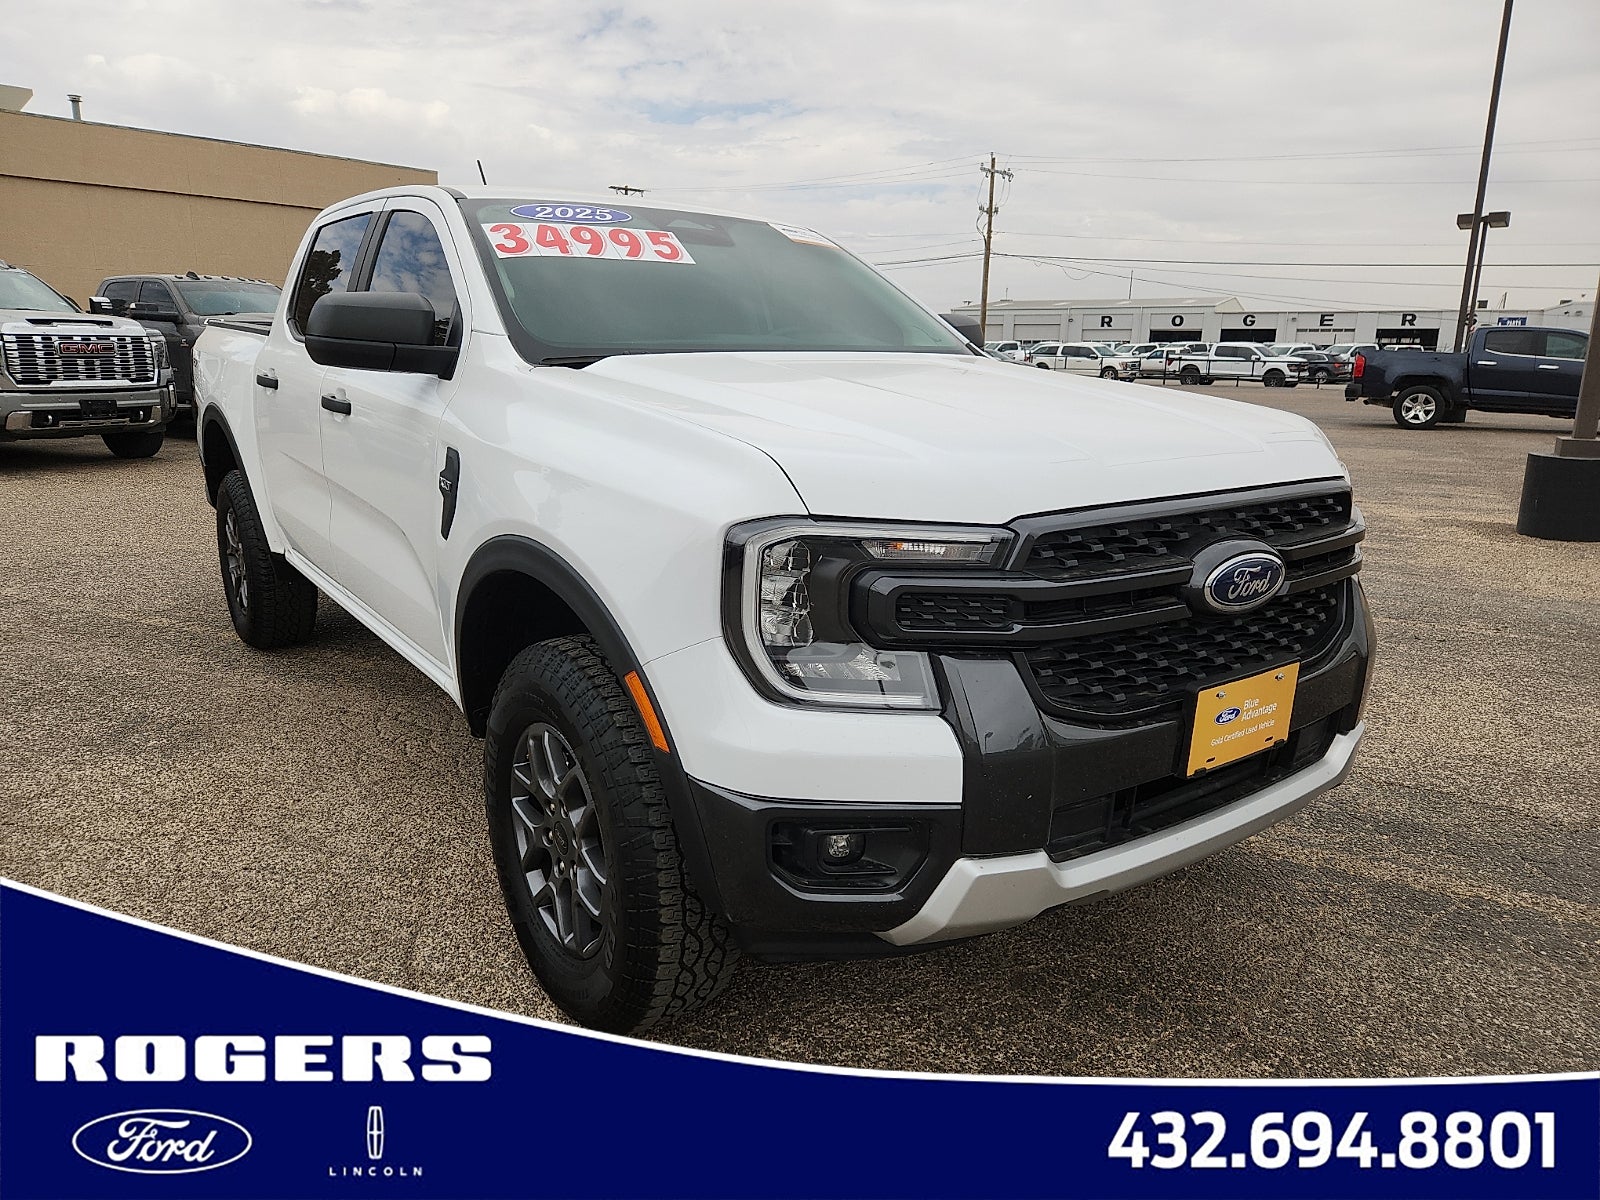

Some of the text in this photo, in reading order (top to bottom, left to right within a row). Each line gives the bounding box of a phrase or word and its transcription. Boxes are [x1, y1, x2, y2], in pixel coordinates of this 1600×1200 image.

[534, 205, 613, 221] 2025
[488, 223, 684, 261] 34995
[61, 343, 115, 354] GMC
[1227, 565, 1272, 600] Ford
[1241, 702, 1278, 722] Advantage
[1243, 698, 1260, 711] Blue
[1210, 718, 1275, 747] Gold Certified Used Vehicle
